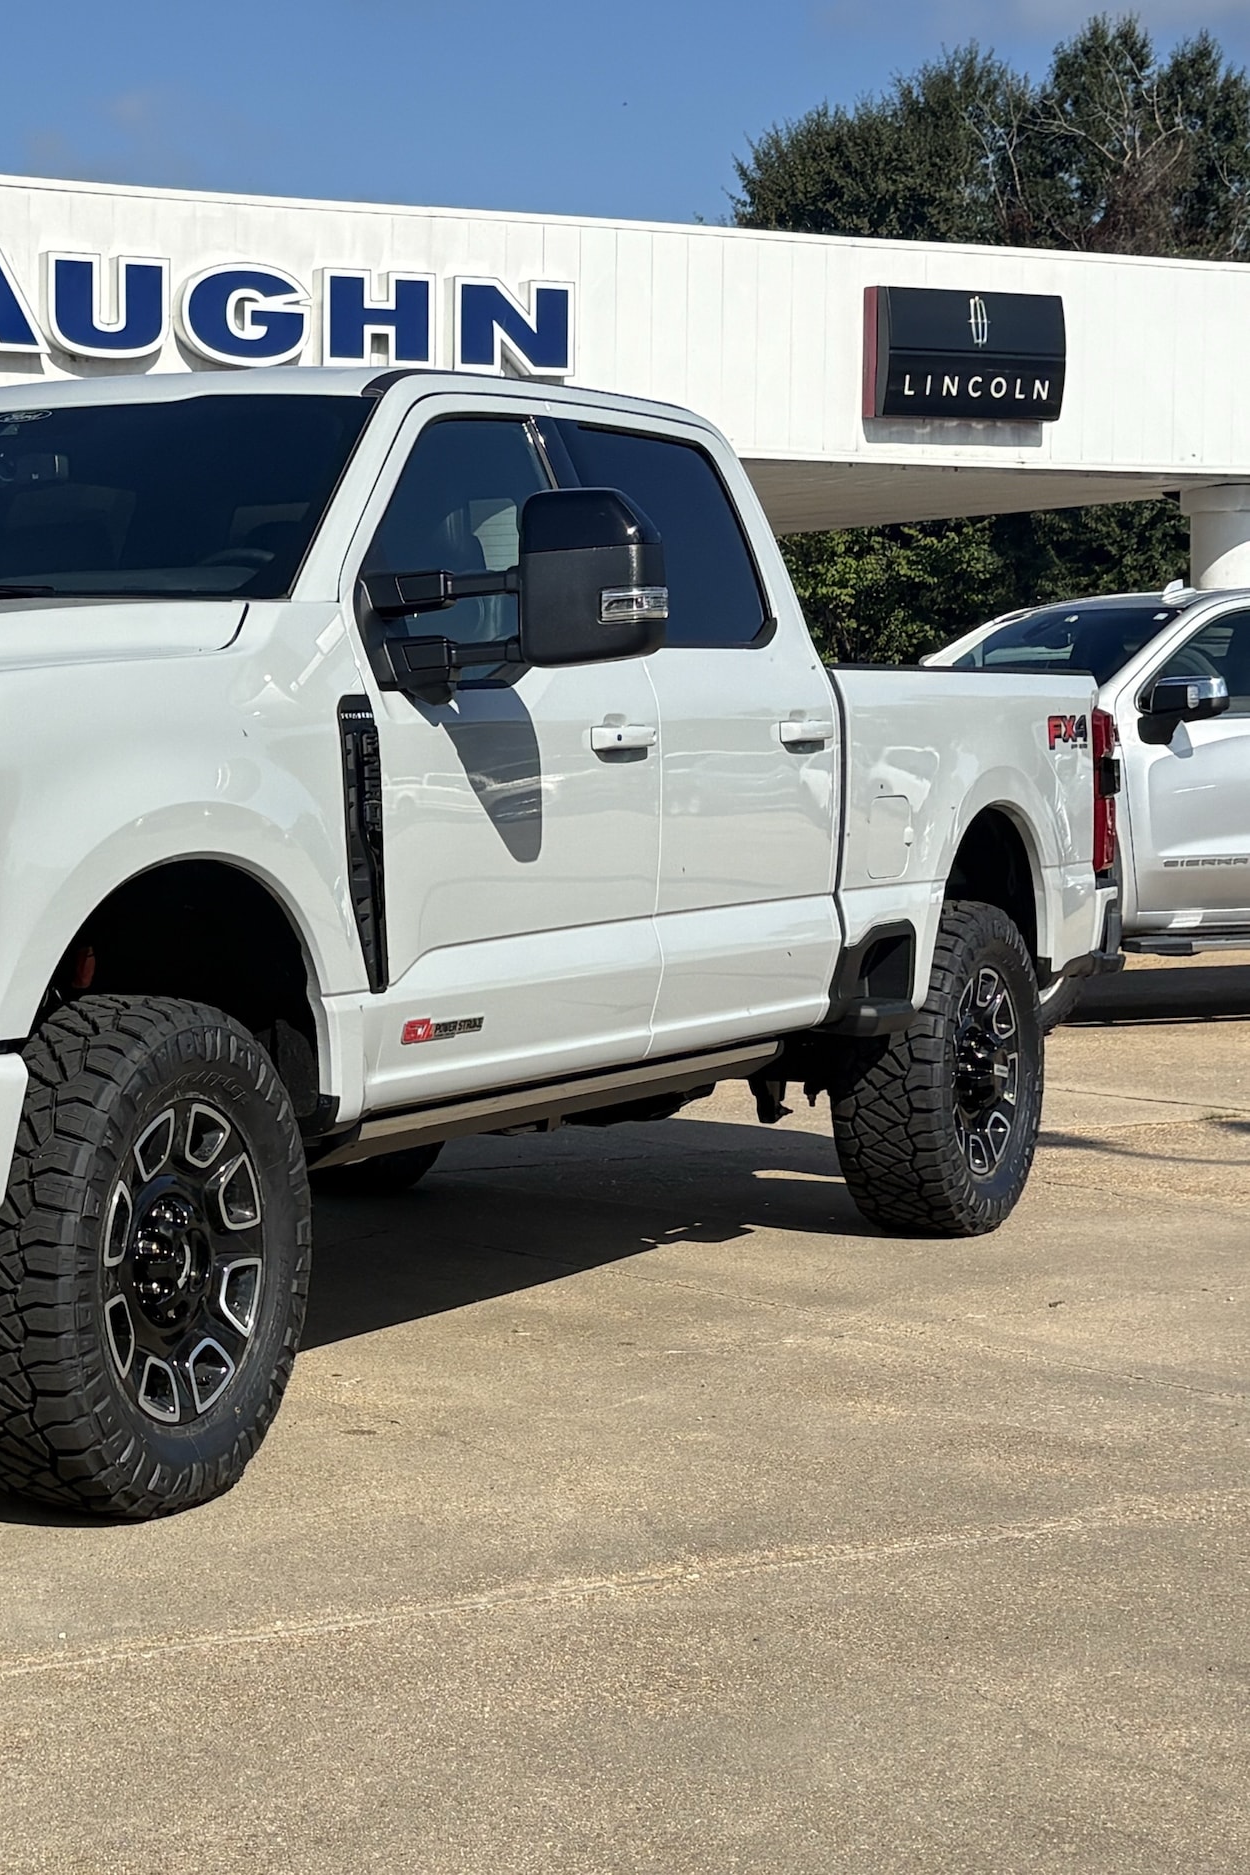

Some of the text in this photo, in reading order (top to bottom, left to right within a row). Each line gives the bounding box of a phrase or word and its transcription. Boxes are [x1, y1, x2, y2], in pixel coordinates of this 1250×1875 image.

[903, 374, 1050, 401] LINCOLN
[1047, 714, 1088, 750] FX4
[1163, 857, 1249, 868] SIERRA
